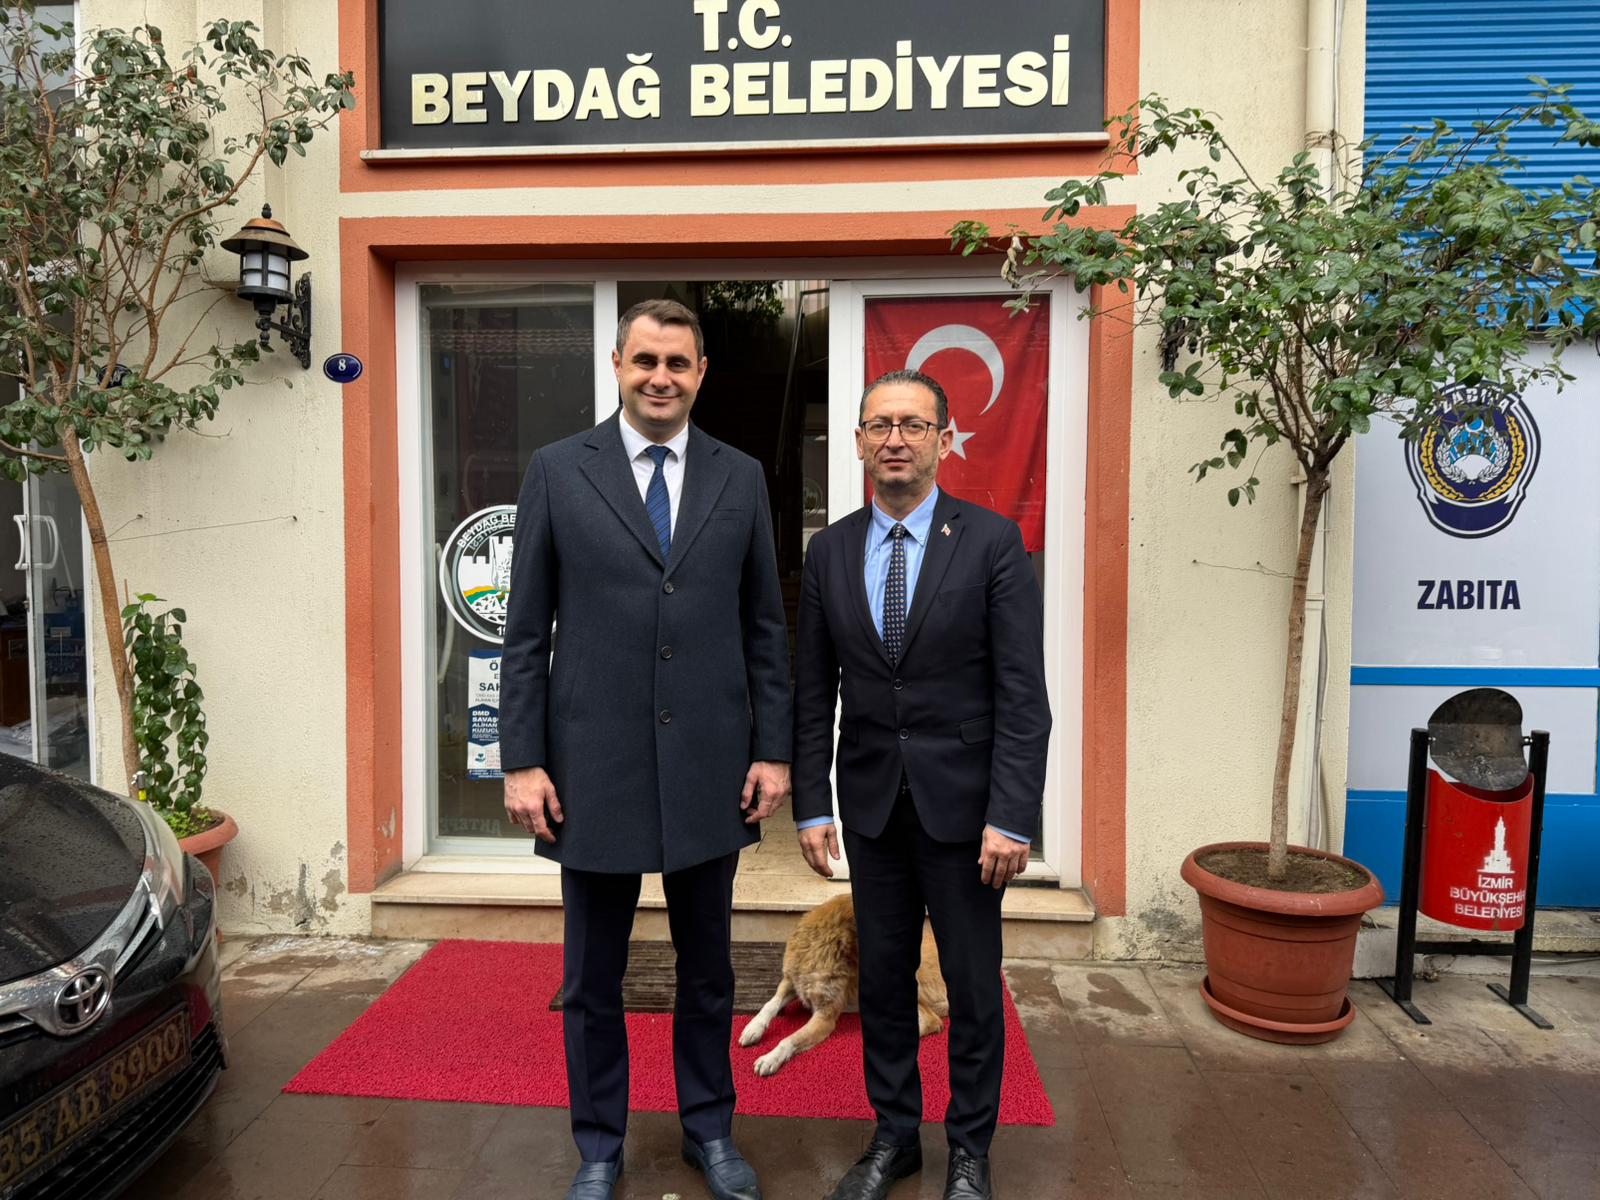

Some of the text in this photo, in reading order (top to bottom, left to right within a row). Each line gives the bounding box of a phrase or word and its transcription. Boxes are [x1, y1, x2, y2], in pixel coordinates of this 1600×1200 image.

[694, 0, 792, 51] T.C.
[411, 34, 1070, 125] BEYDAĞ BELEDİYESİ
[338, 358, 347, 371] 8
[1417, 580, 1521, 610] ZABITA
[1478, 874, 1514, 889] İZMİR
[0, 1023, 180, 1182] 35 AB 8900
